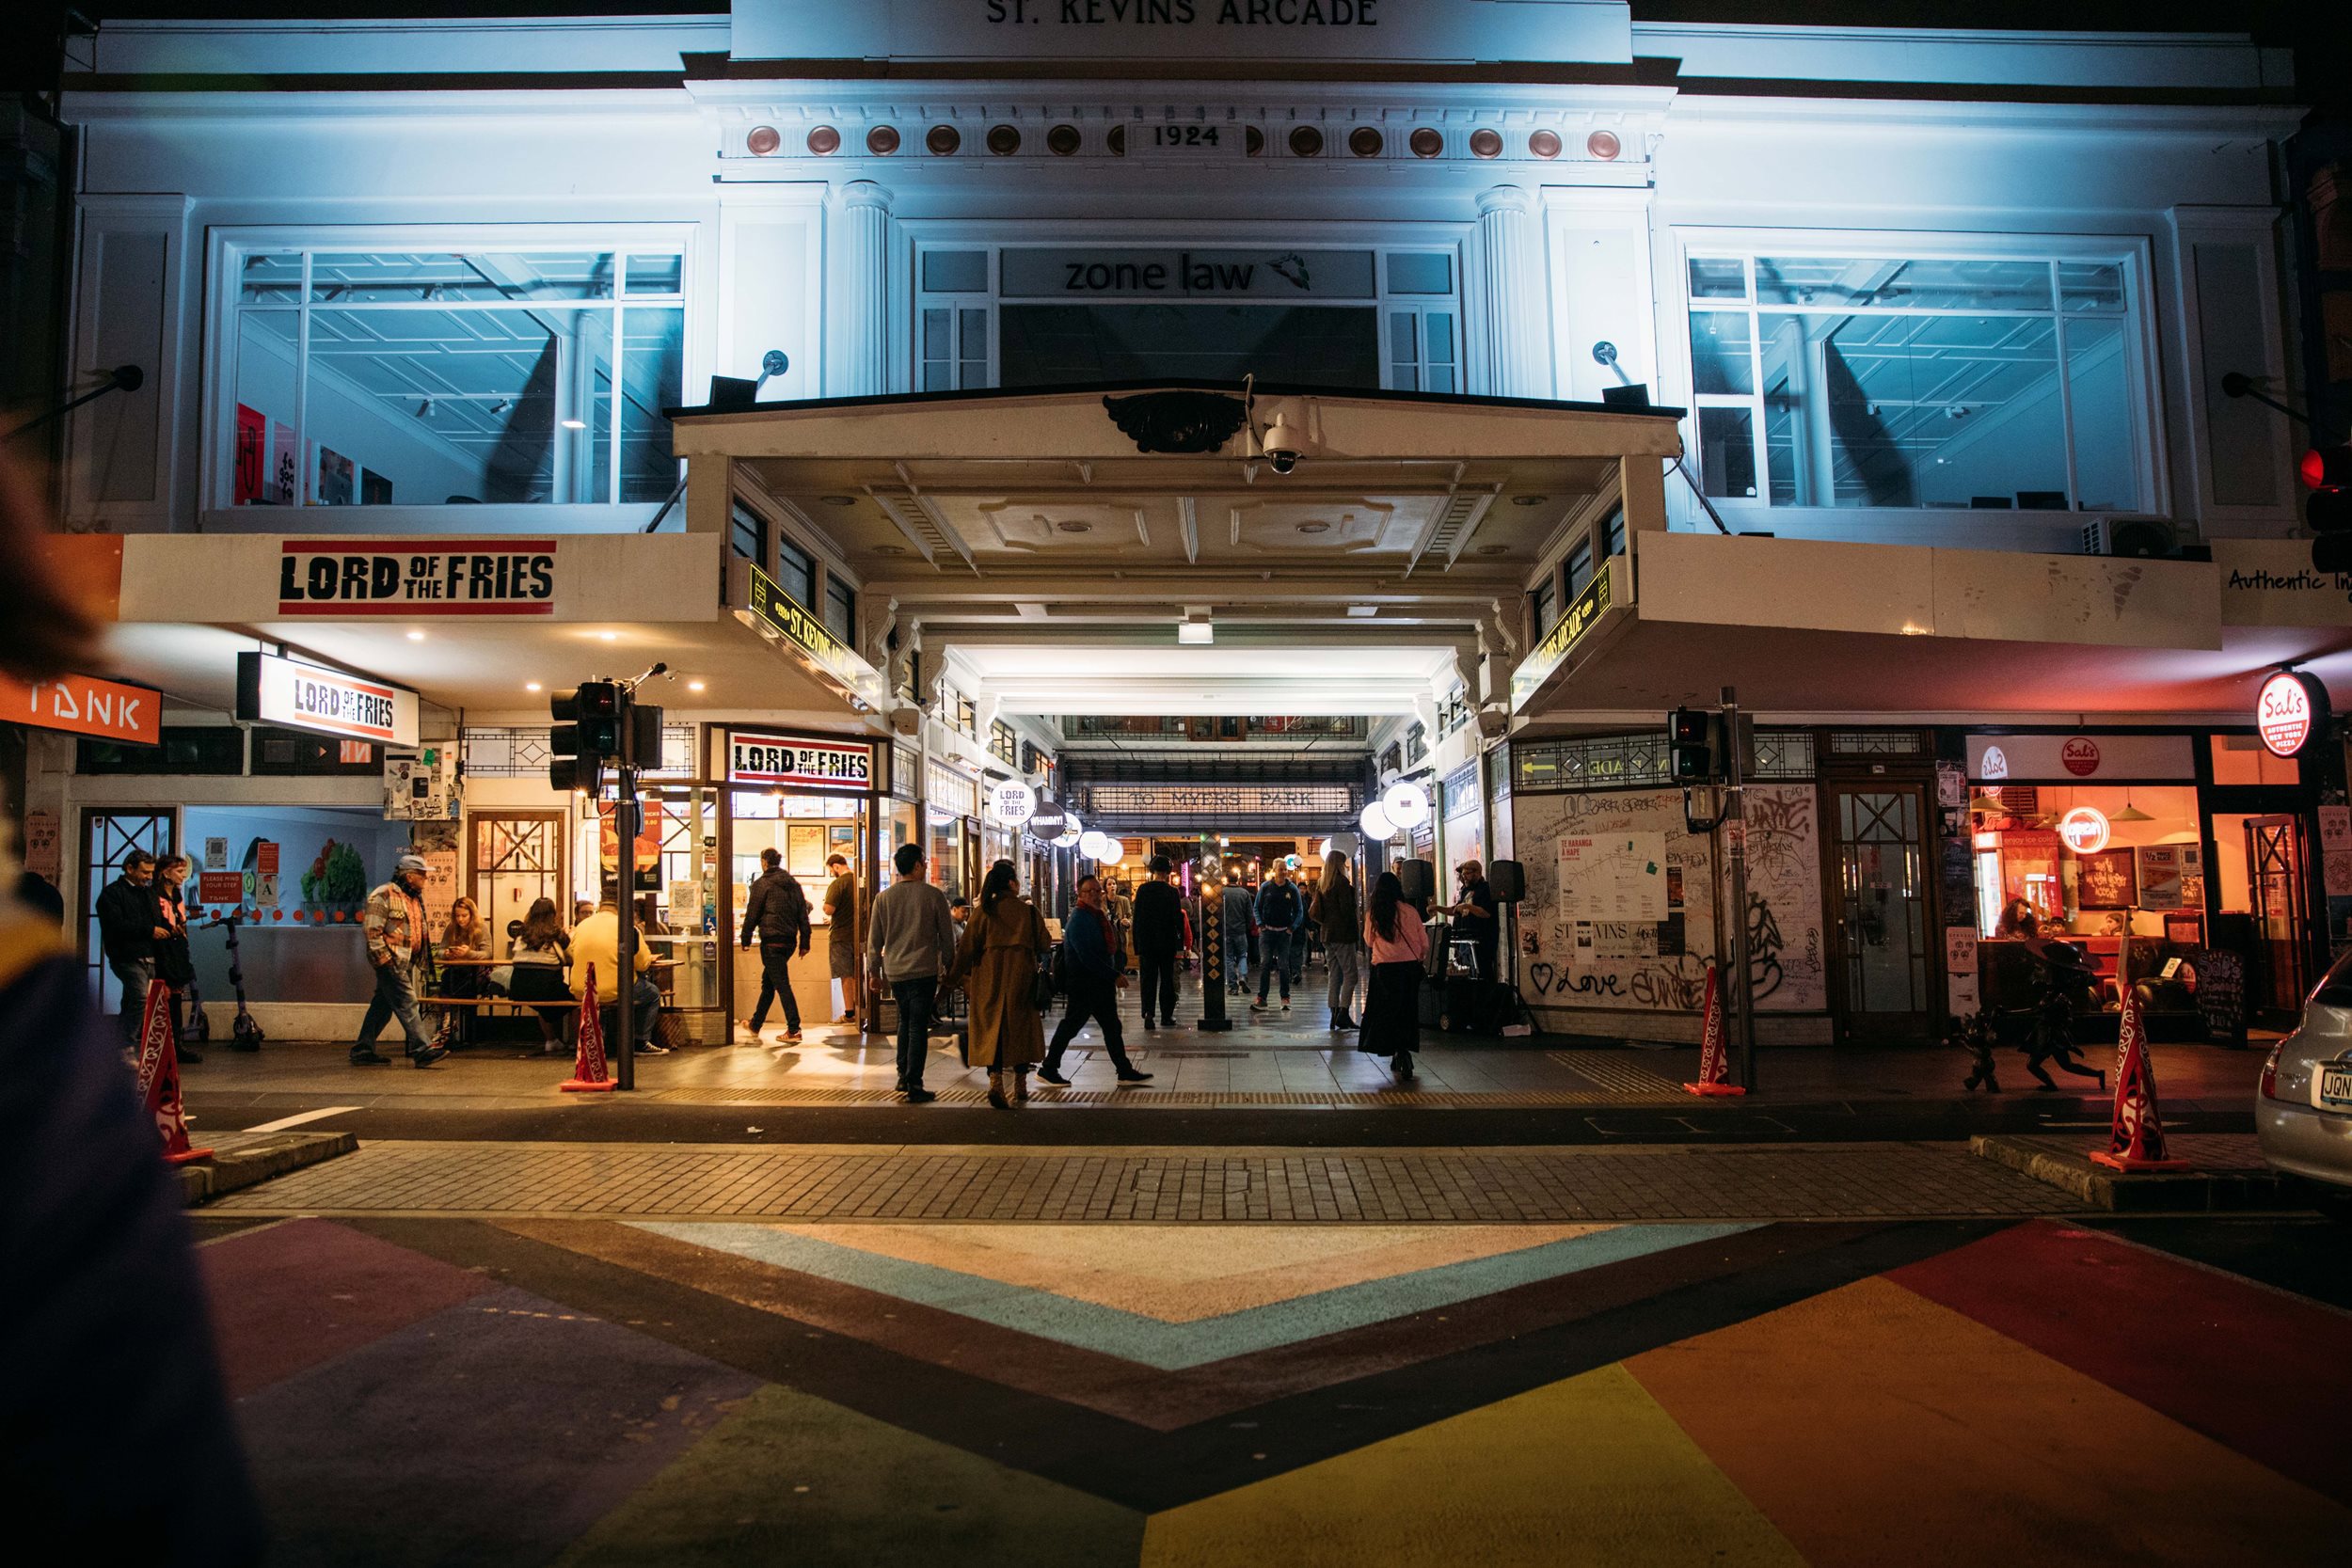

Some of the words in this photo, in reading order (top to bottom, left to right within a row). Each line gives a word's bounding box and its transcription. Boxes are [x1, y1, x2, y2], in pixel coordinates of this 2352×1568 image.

[986, 0, 1040, 24] ST.
[1059, 0, 1196, 24] KEVINS
[1217, 0, 1378, 26] ARCADE
[1154, 125, 1219, 147] 1924
[1065, 262, 1166, 291] zone
[1181, 253, 1255, 290] law
[279, 556, 400, 600] LORD
[409, 556, 440, 578] OF
[446, 555, 554, 599] FRIES
[404, 579, 442, 599] THE
[2229, 569, 2327, 591] Authentic
[2335, 572, 2352, 591] In
[803, 618, 831, 659] KEVINS
[1557, 605, 1582, 653] ARCADE
[294, 678, 340, 716] LORD
[343, 690, 354, 706] OF
[357, 694, 393, 728] FRIES
[2265, 689, 2303, 719] Sal's
[2267, 722, 2303, 734] AUTHENTIC
[2268, 733, 2282, 741] NEW
[735, 745, 795, 773] LORD
[800, 750, 814, 763] OF
[2067, 744, 2095, 757] Sal's
[797, 763, 816, 775] THE
[818, 752, 868, 778] FRIES
[1000, 790, 1025, 800] LORD
[1129, 793, 1155, 806] TO
[1171, 792, 1242, 806] MYERS
[1259, 791, 1314, 806] PARK
[1000, 805, 1025, 816] FRIES
[1031, 816, 1063, 826] WHAMMY!
[2005, 836, 2024, 845] enjoy
[2039, 834, 2055, 843] cold
[262, 883, 272, 895] A
[1593, 923, 1628, 940] VINS
[1557, 966, 1627, 997] Love
